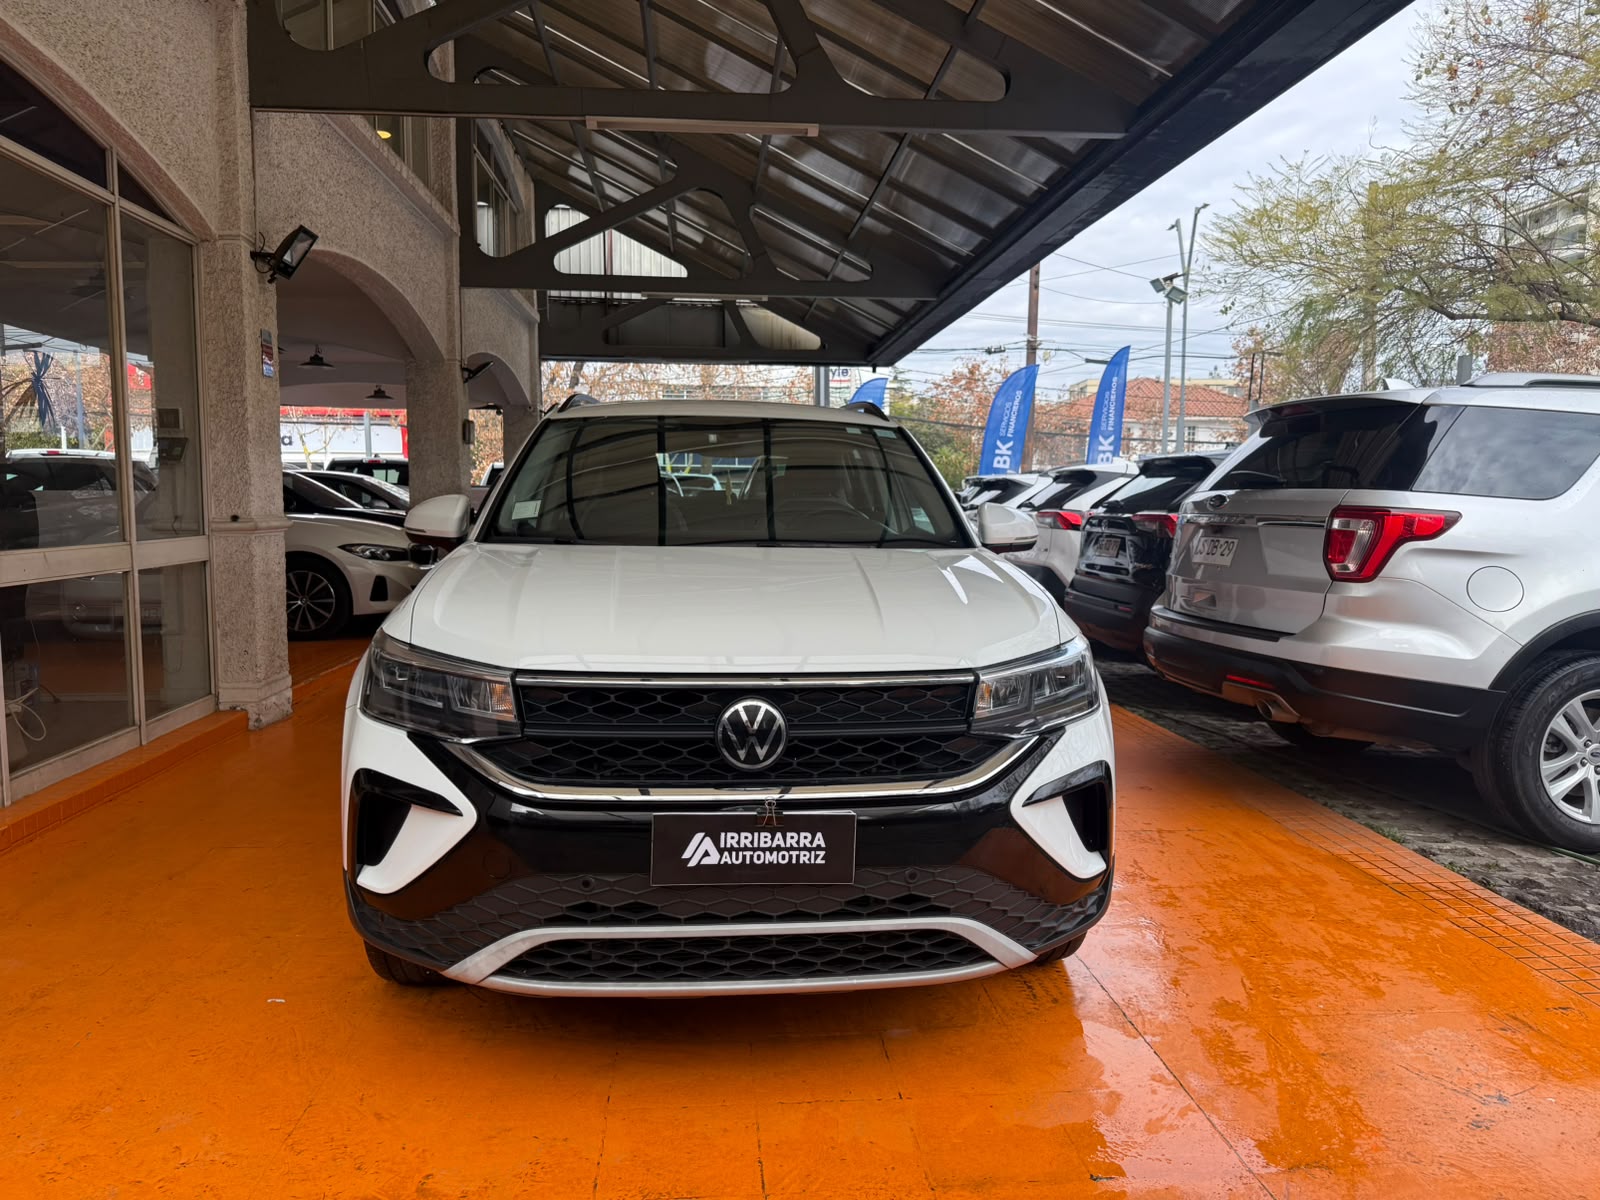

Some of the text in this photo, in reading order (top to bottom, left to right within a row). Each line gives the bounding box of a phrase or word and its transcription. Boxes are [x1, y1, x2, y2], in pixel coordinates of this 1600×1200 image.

[999, 401, 1012, 437] SERVICIOS
[1006, 389, 1023, 438] FINANCIEROS
[1100, 391, 1110, 431] SERVICIOS
[1107, 376, 1118, 431] FINANCIEROS
[992, 439, 1014, 469] BK
[1097, 434, 1115, 465] BK
[719, 832, 826, 848] IRRIBARRA
[719, 850, 826, 865] AUTOMOTRIZ
